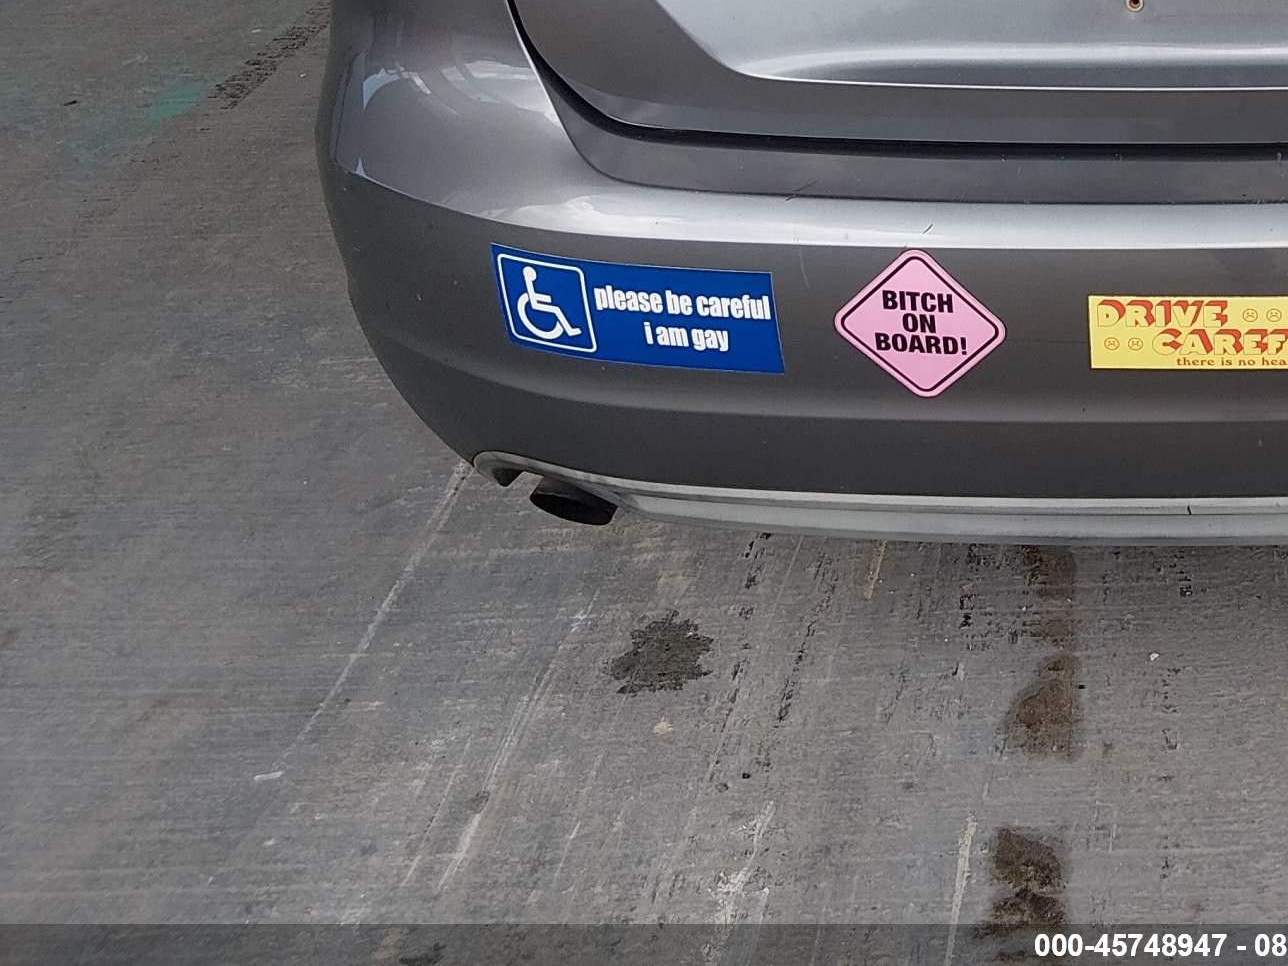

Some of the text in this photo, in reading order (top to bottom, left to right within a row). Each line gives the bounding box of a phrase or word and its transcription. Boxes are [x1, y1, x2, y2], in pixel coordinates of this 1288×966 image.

[593, 285, 772, 320] please be careful
[882, 290, 954, 313] BITCH
[1096, 299, 1228, 327] DRIVE
[902, 313, 937, 333] ON
[643, 321, 729, 352] i am gay
[874, 332, 968, 356] BOARD!
[1176, 357, 1216, 367] there
[1220, 357, 1233, 367] is
[1238, 358, 1256, 367] no
